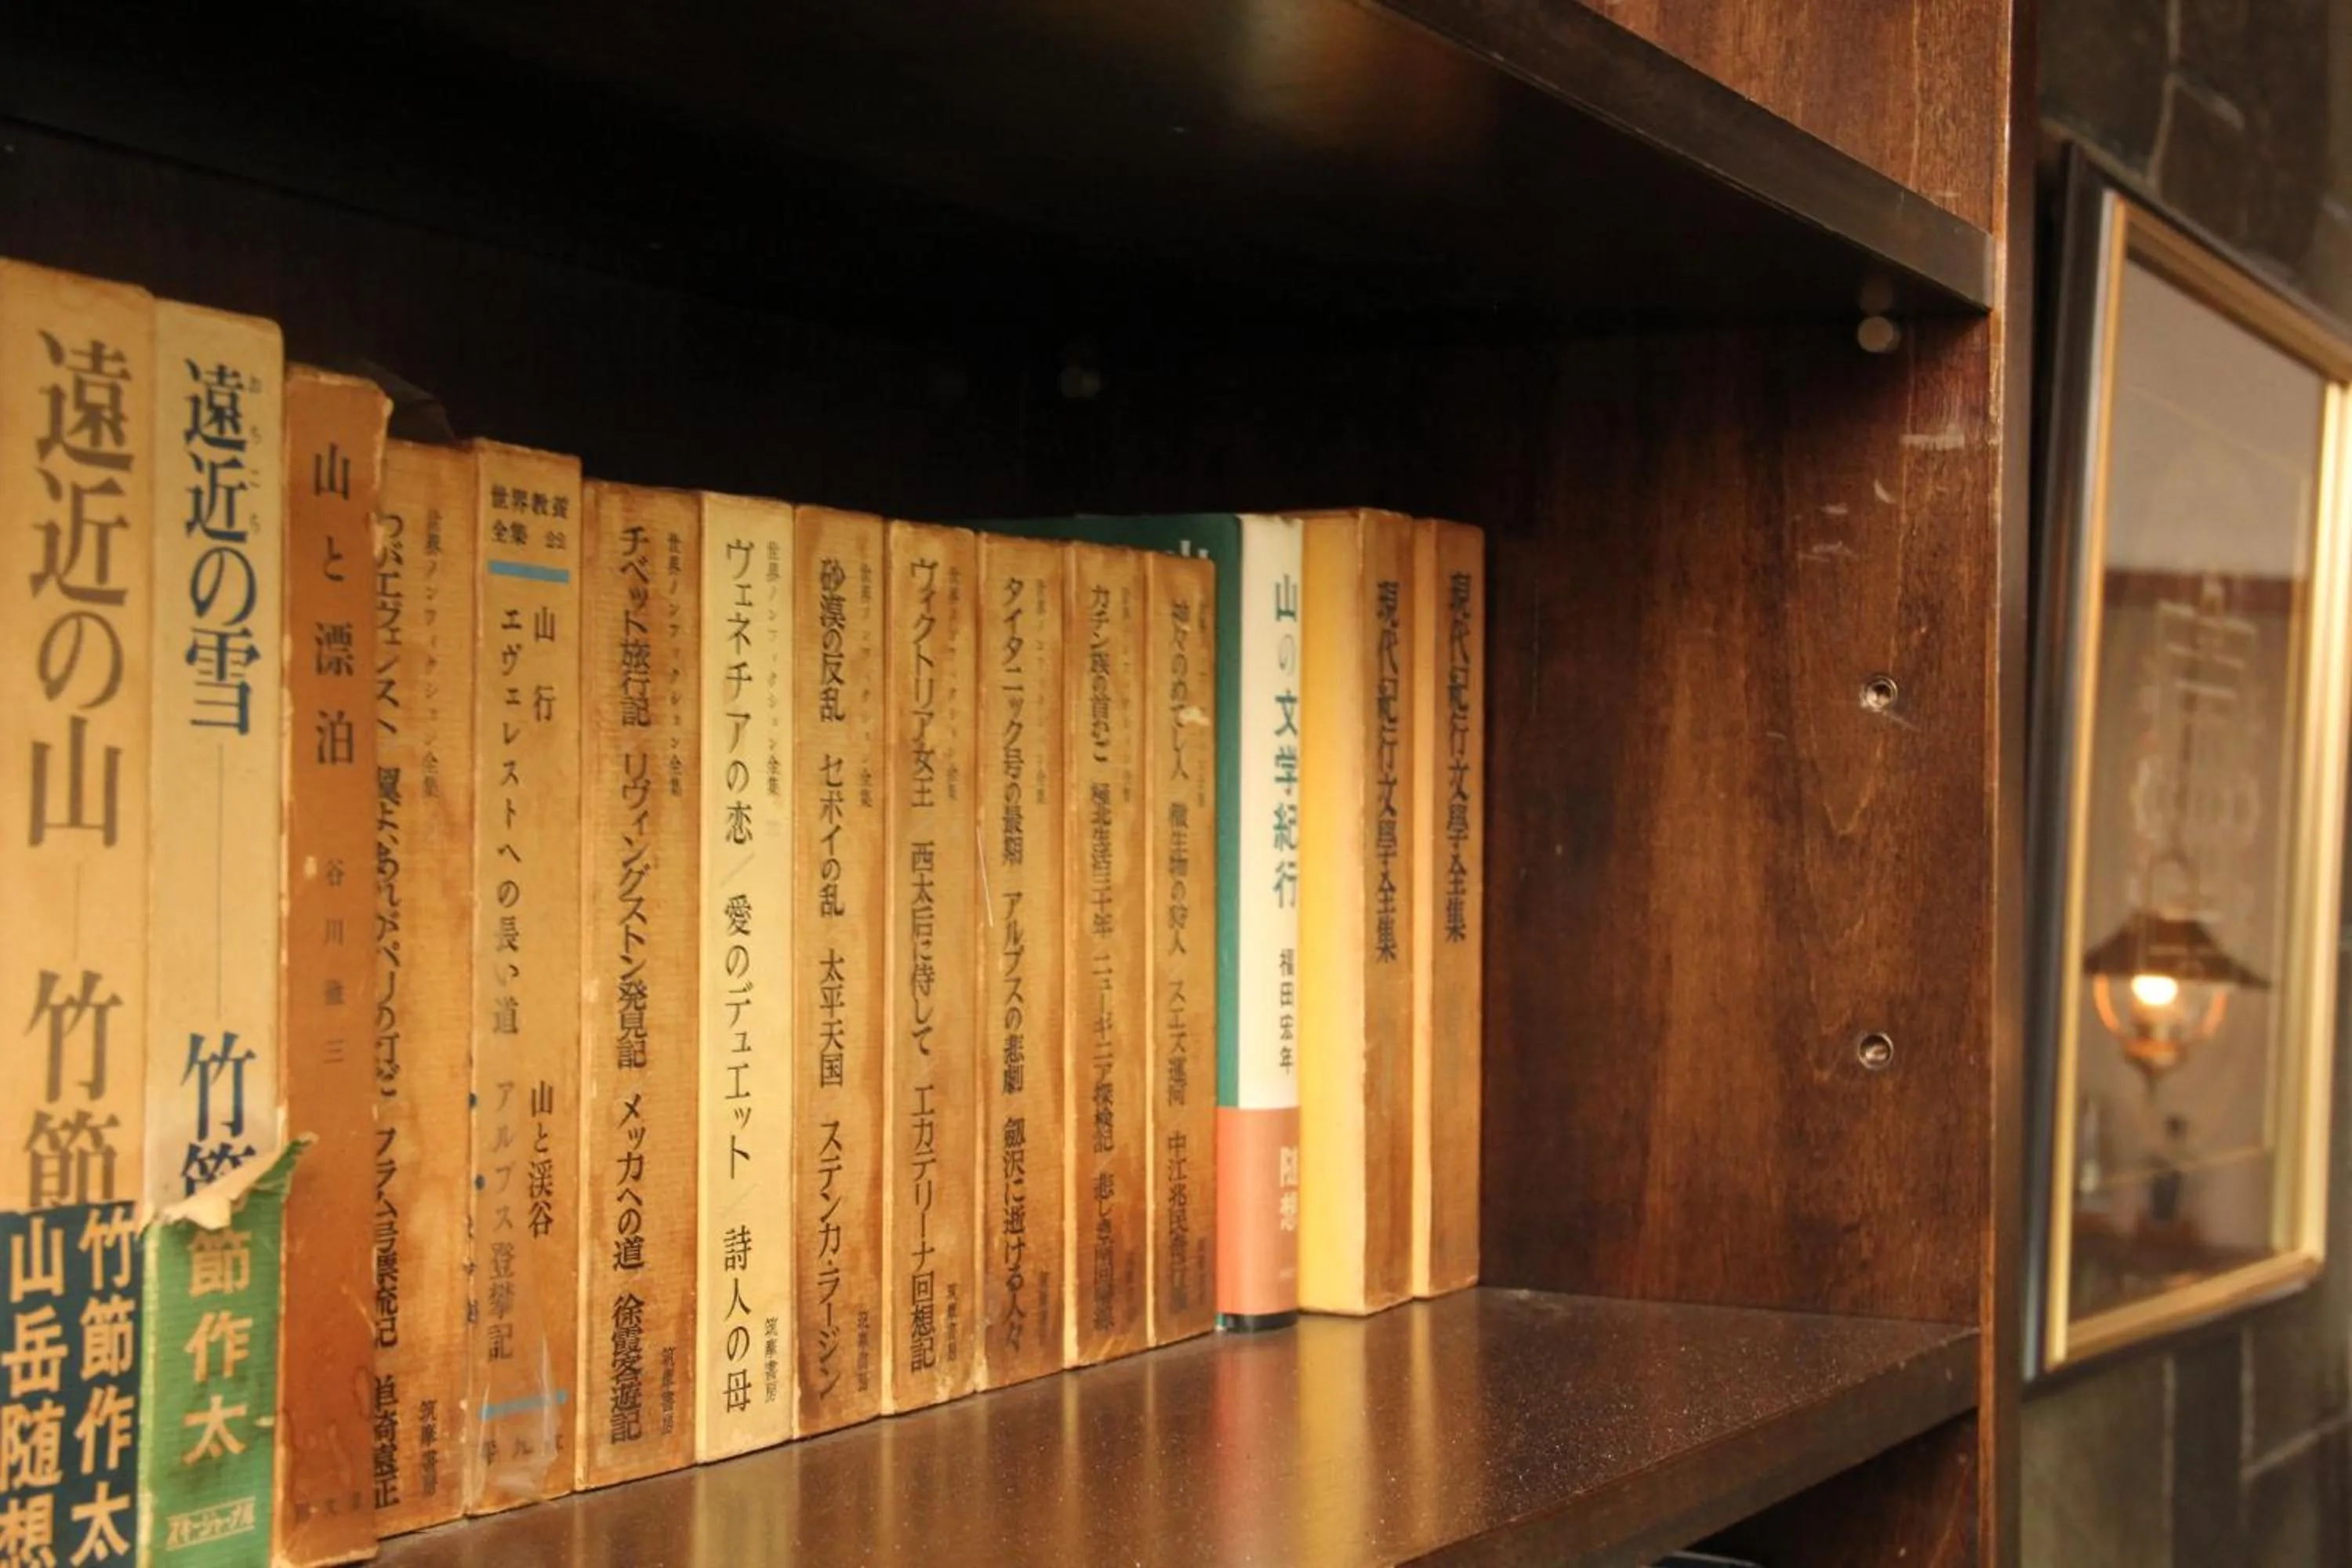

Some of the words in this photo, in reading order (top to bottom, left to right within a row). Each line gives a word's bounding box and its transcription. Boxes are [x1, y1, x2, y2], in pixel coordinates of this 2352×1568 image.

[28, 328, 134, 848] 遠近の山
[183, 358, 260, 737] 遠近の雪
[314, 443, 354, 766] 山と漂泊
[490, 482, 568, 520] 世界教養
[491, 518, 527, 547] 全集
[619, 524, 652, 728] チベット旅行記
[534, 608, 556, 722] 山行
[726, 539, 754, 844] ヴェネチアの恋
[819, 558, 846, 723] 砂漠の反乱
[909, 557, 939, 808] ヴィクトリア女王
[1272, 574, 1298, 909] 山の文学紀行
[492, 608, 521, 1035] エヴェレストへの長い道
[617, 753, 652, 1069] リヴィングストン発見記
[819, 753, 845, 918] セポイの乱
[724, 894, 754, 1180] 愛のデュエット
[818, 949, 845, 1088] 太平天国
[910, 840, 937, 1055] 西太后に侍して
[1002, 891, 1025, 1095] アルプスの悲劇
[528, 1080, 554, 1239] 山と渓谷
[615, 1094, 644, 1272] メッカへの道
[817, 1120, 843, 1401] ステンカ・ラージン
[910, 1083, 936, 1372] エカテリーナ回想記
[0, 1217, 69, 1568] 山岳随想
[70, 1207, 136, 1567] 竹節作太
[723, 1225, 753, 1414] 詩人の母
